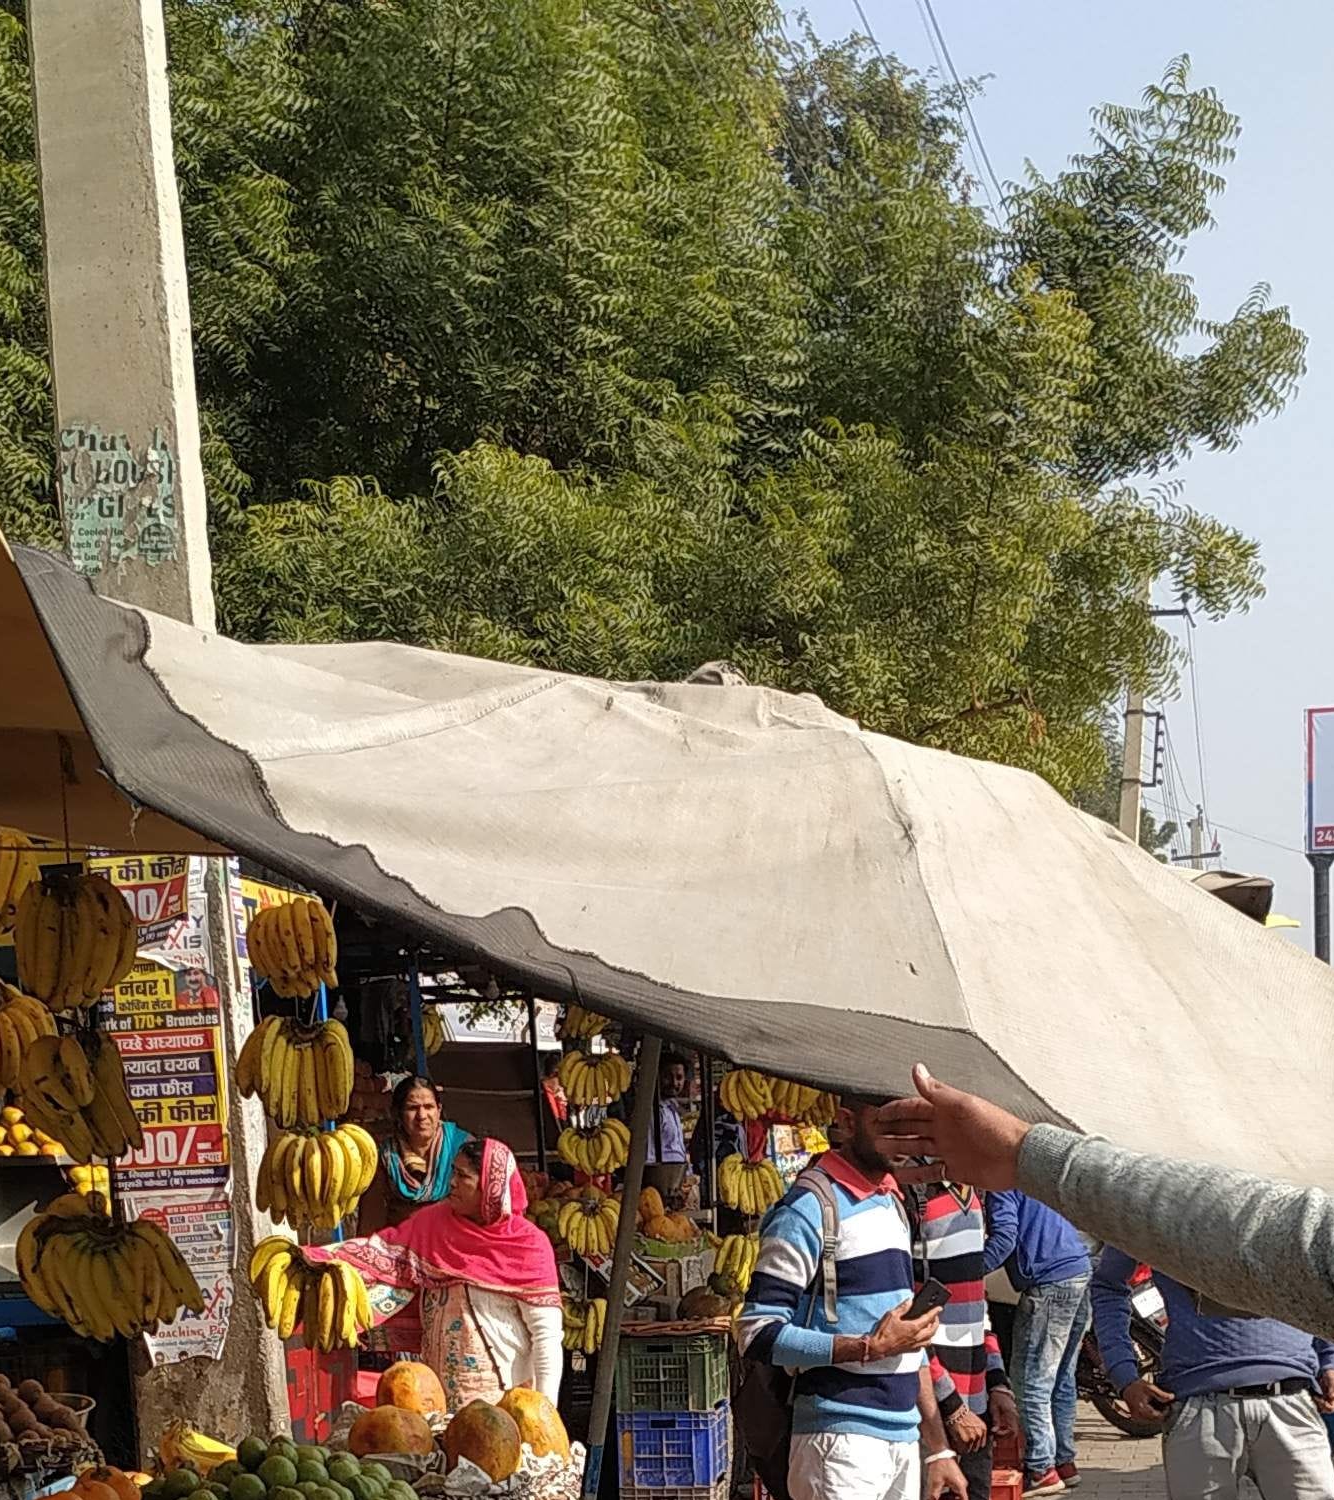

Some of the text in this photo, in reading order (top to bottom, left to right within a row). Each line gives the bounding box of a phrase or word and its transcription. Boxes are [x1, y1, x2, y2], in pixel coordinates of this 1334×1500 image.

[98, 494, 174, 518] GILS
[116, 858, 145, 881] की
[163, 978, 170, 995] 1
[120, 1017, 132, 1030] of
[134, 1014, 164, 1029] 170+
[166, 1012, 218, 1027] Branches
[145, 1033, 205, 1050] अध्यापक
[164, 1057, 200, 1072] चयन
[131, 1078, 194, 1098] कम फीस
[137, 1101, 163, 1124] की
